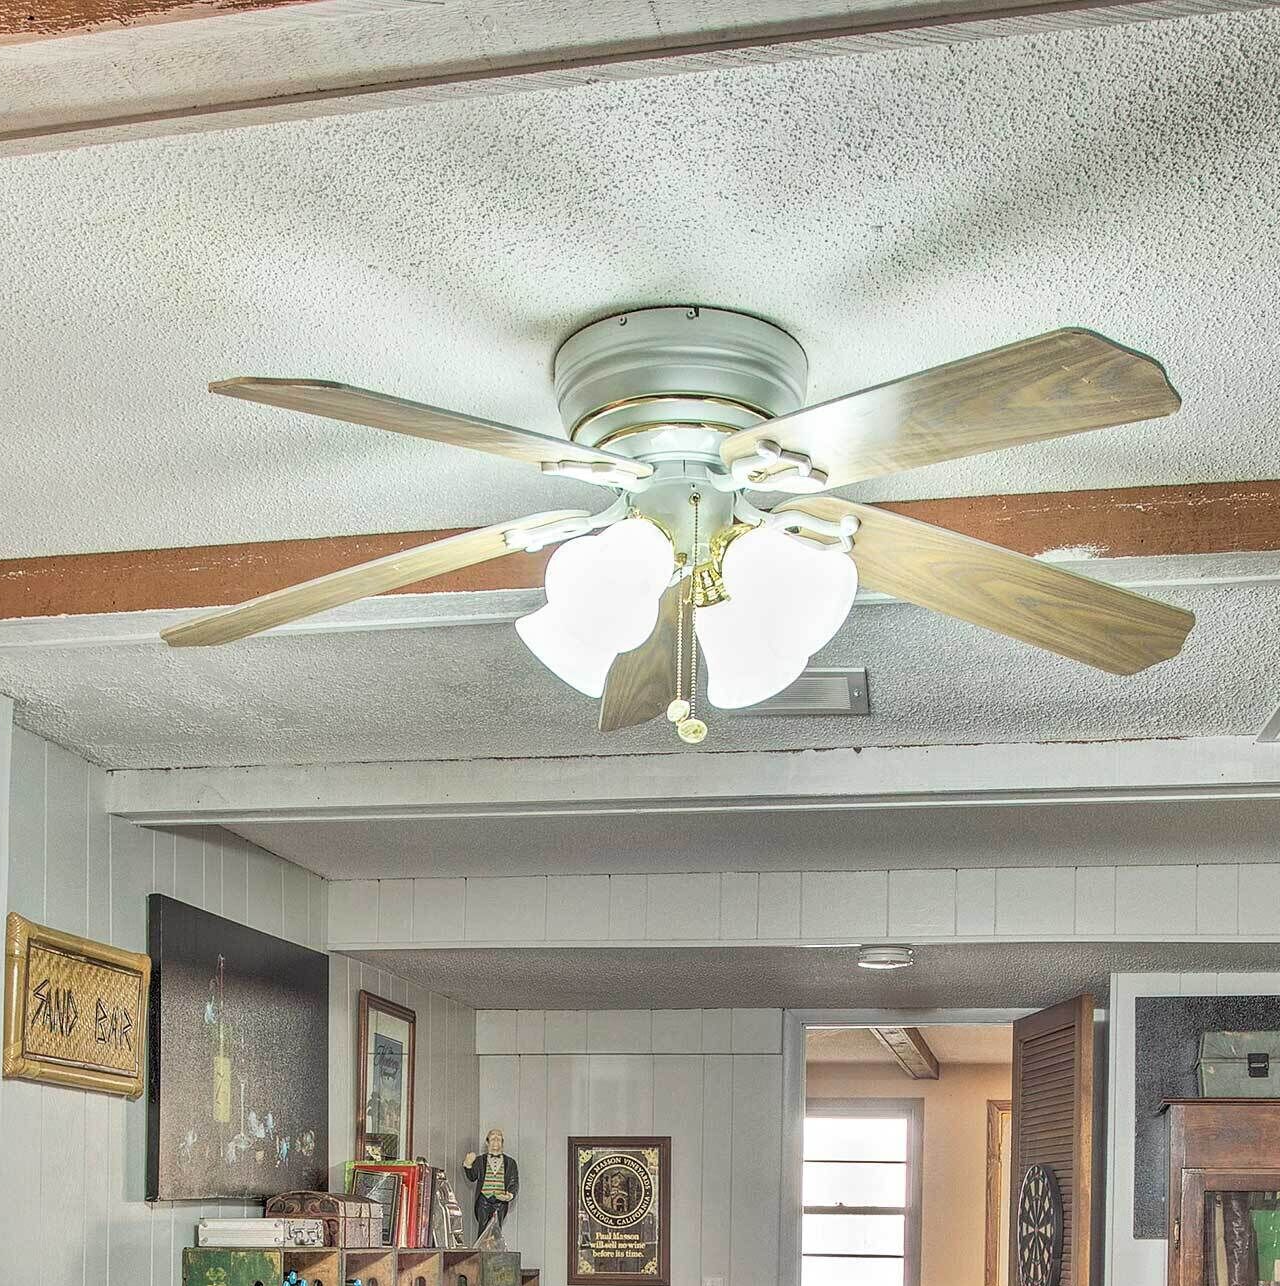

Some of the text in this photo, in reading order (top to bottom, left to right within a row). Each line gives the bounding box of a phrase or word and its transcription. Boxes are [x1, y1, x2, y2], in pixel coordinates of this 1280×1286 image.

[31, 978, 133, 1052] SAND BAR
[585, 1157, 651, 1190] PAUL MASSON VINEYARDS
[616, 1196, 651, 1225] CALIFORNIA
[595, 1232, 640, 1240] Paul Masson
[592, 1250, 615, 1258] before
